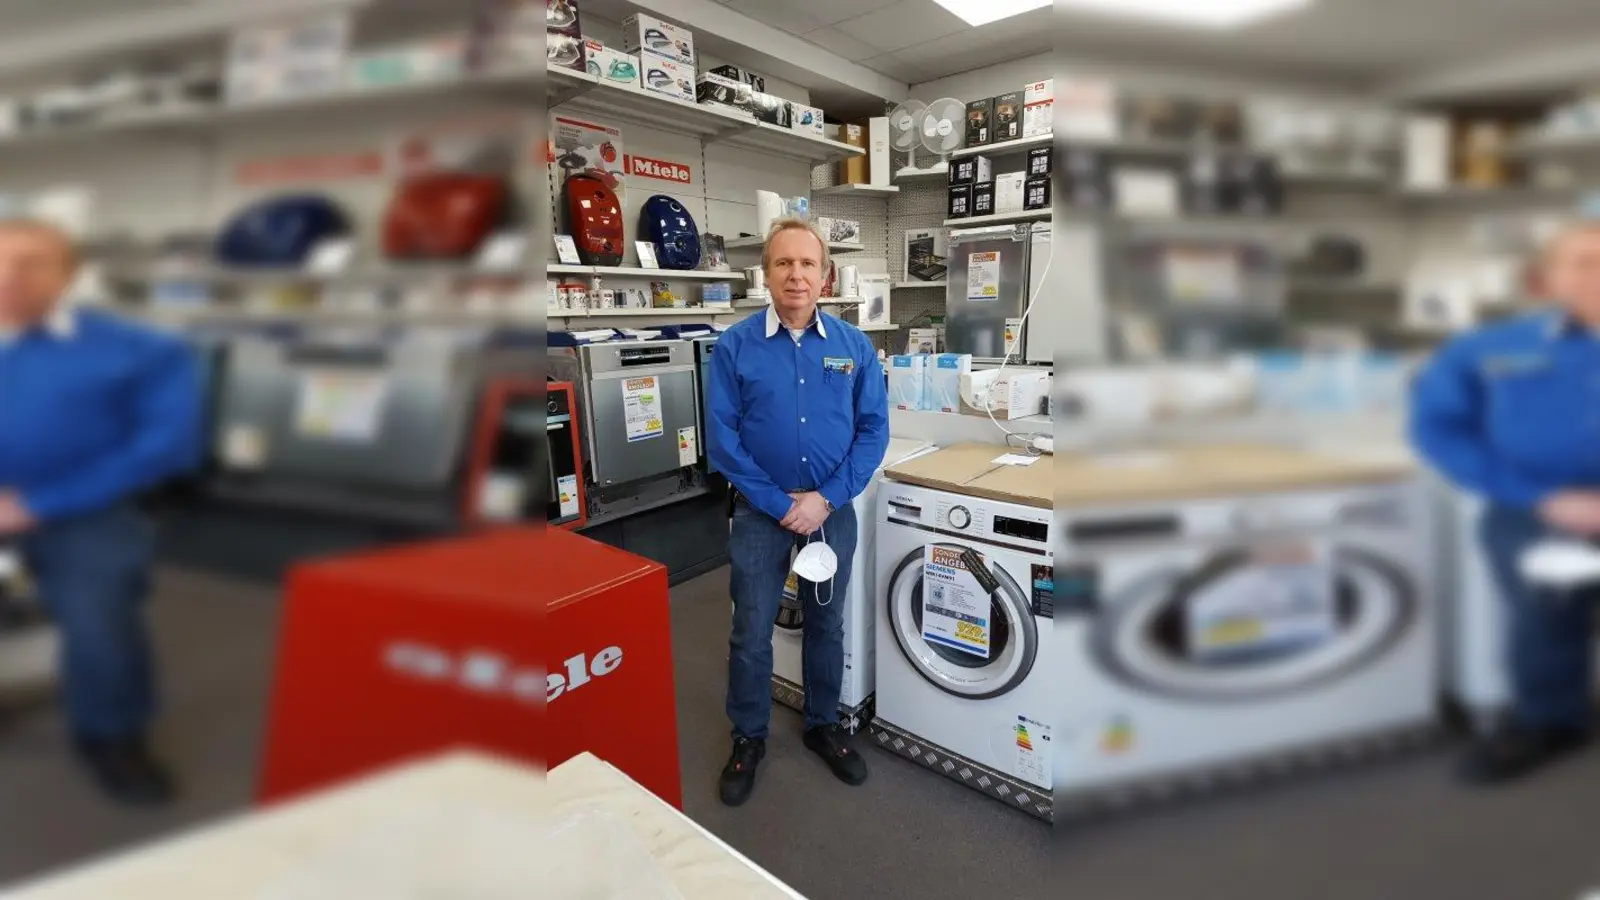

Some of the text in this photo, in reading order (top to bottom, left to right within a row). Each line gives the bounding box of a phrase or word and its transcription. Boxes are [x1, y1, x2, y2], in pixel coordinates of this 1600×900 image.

[634, 159, 689, 180] Miele
[934, 548, 960, 558] SONDE
[926, 564, 956, 575] SIEMENS
